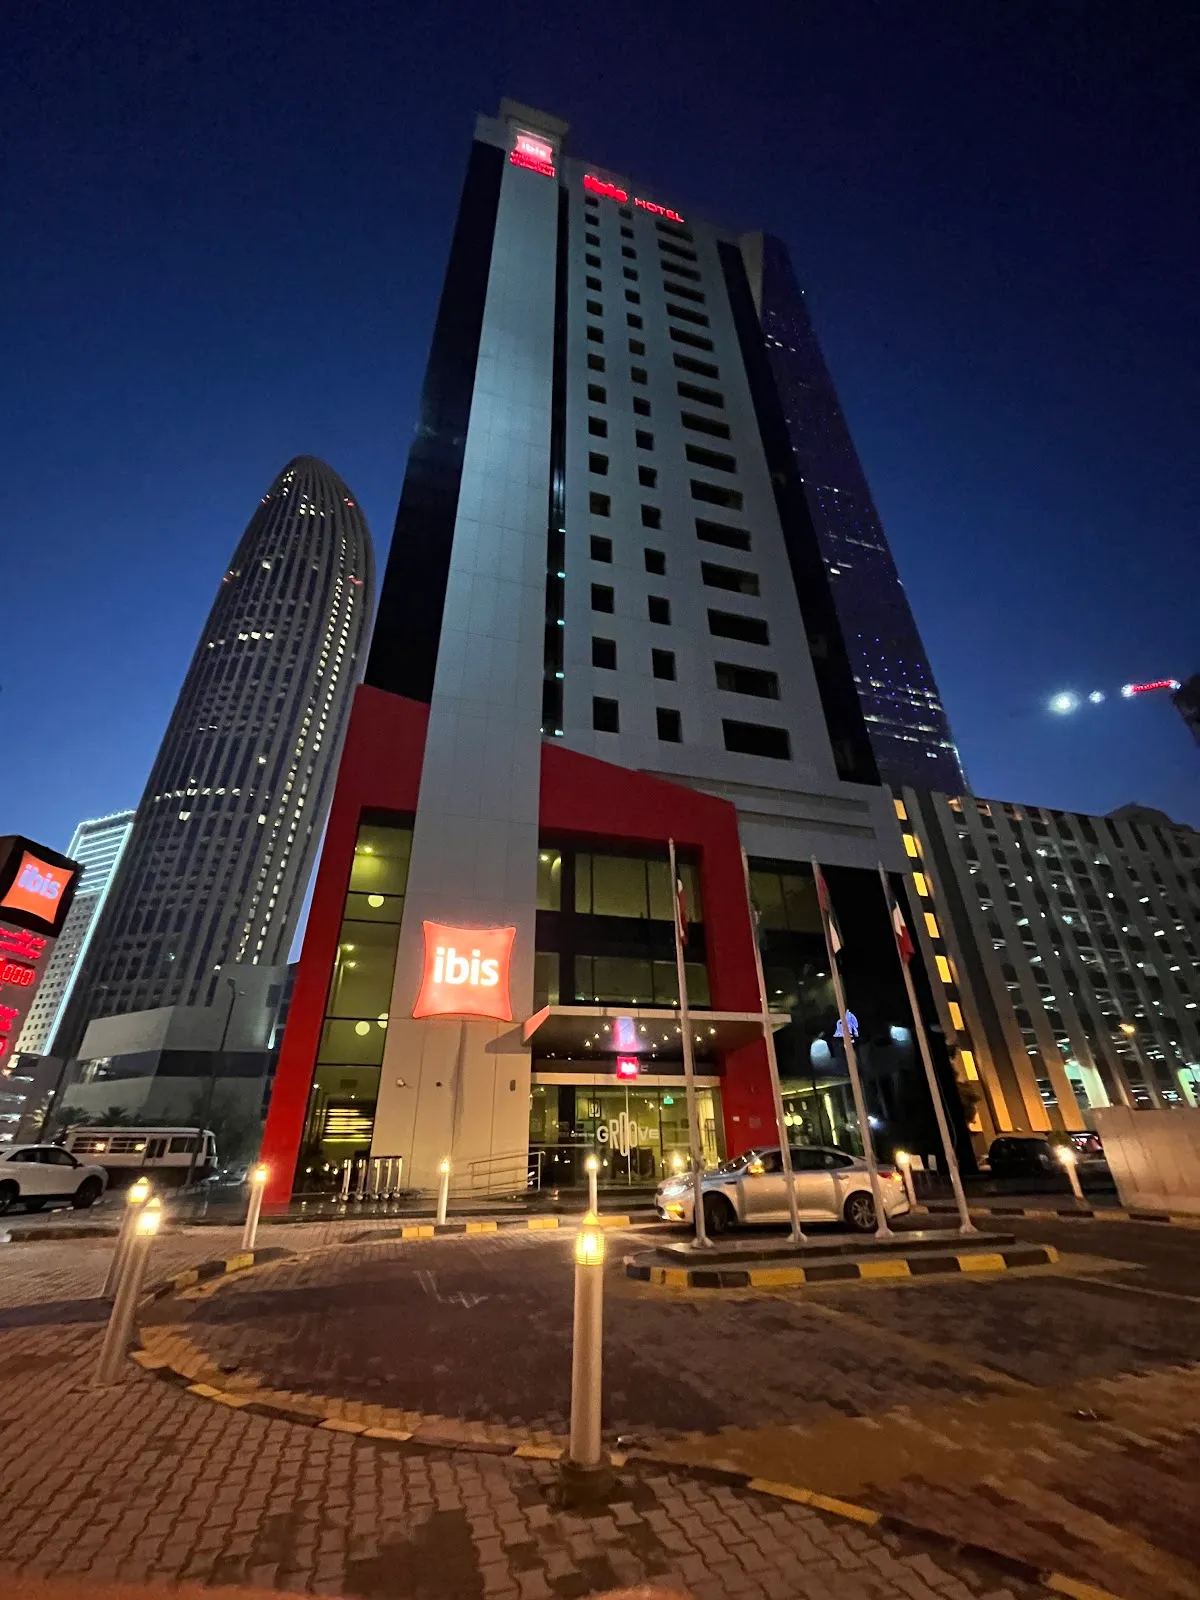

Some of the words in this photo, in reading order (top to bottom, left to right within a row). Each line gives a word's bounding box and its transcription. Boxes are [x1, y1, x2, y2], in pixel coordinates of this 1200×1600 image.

[634, 197, 685, 223] HOTEL
[18, 863, 61, 900] ibis
[433, 946, 500, 987] ibis
[596, 1112, 660, 1157] GROOVE
